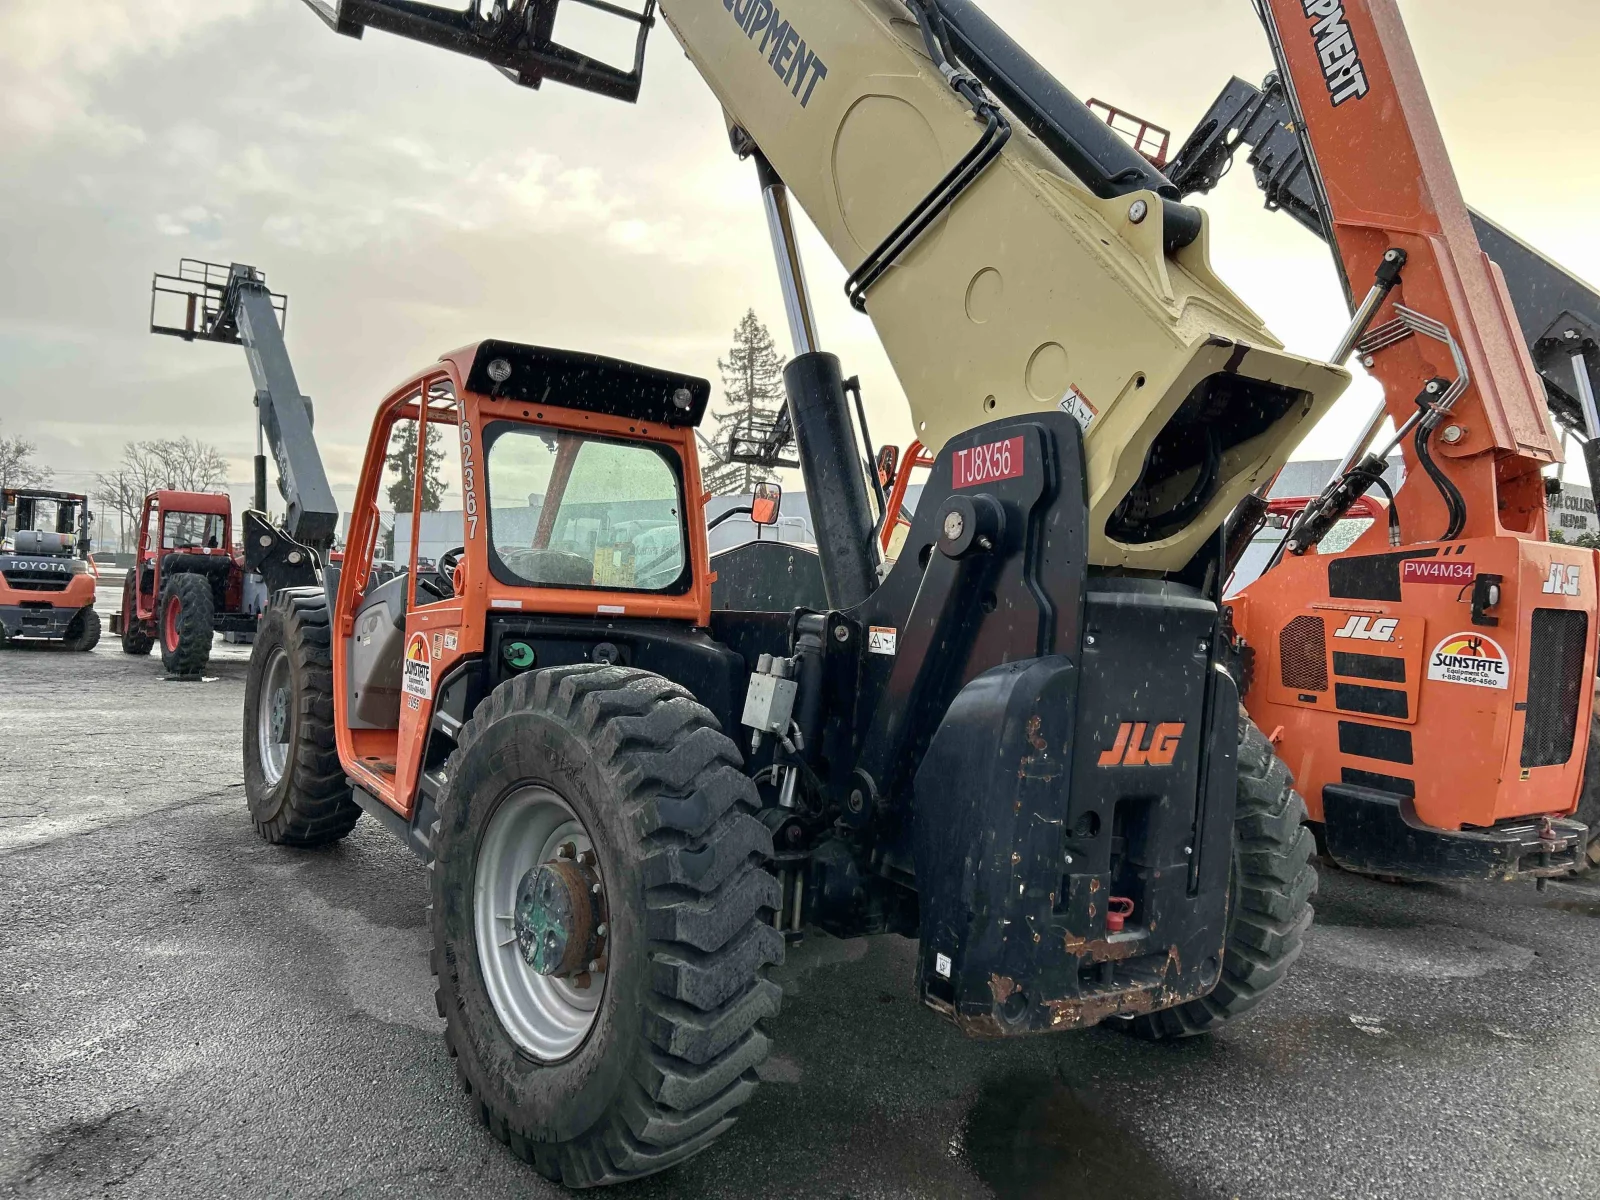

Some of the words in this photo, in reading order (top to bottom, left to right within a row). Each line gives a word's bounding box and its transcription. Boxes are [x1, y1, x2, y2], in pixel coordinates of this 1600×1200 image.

[722, 0, 828, 109] UIPMENT
[1301, 0, 1369, 107] PMENT
[458, 399, 479, 541] 162367
[958, 439, 1011, 484] TJ8X56
[11, 561, 66, 572] TOYOTA
[1404, 562, 1473, 578] PW4M34
[1542, 562, 1581, 596] JLG
[1332, 615, 1400, 642] JLG
[1432, 652, 1505, 675] SUNSTATE
[1446, 667, 1480, 677] Equipment
[1097, 721, 1187, 768] JLG
